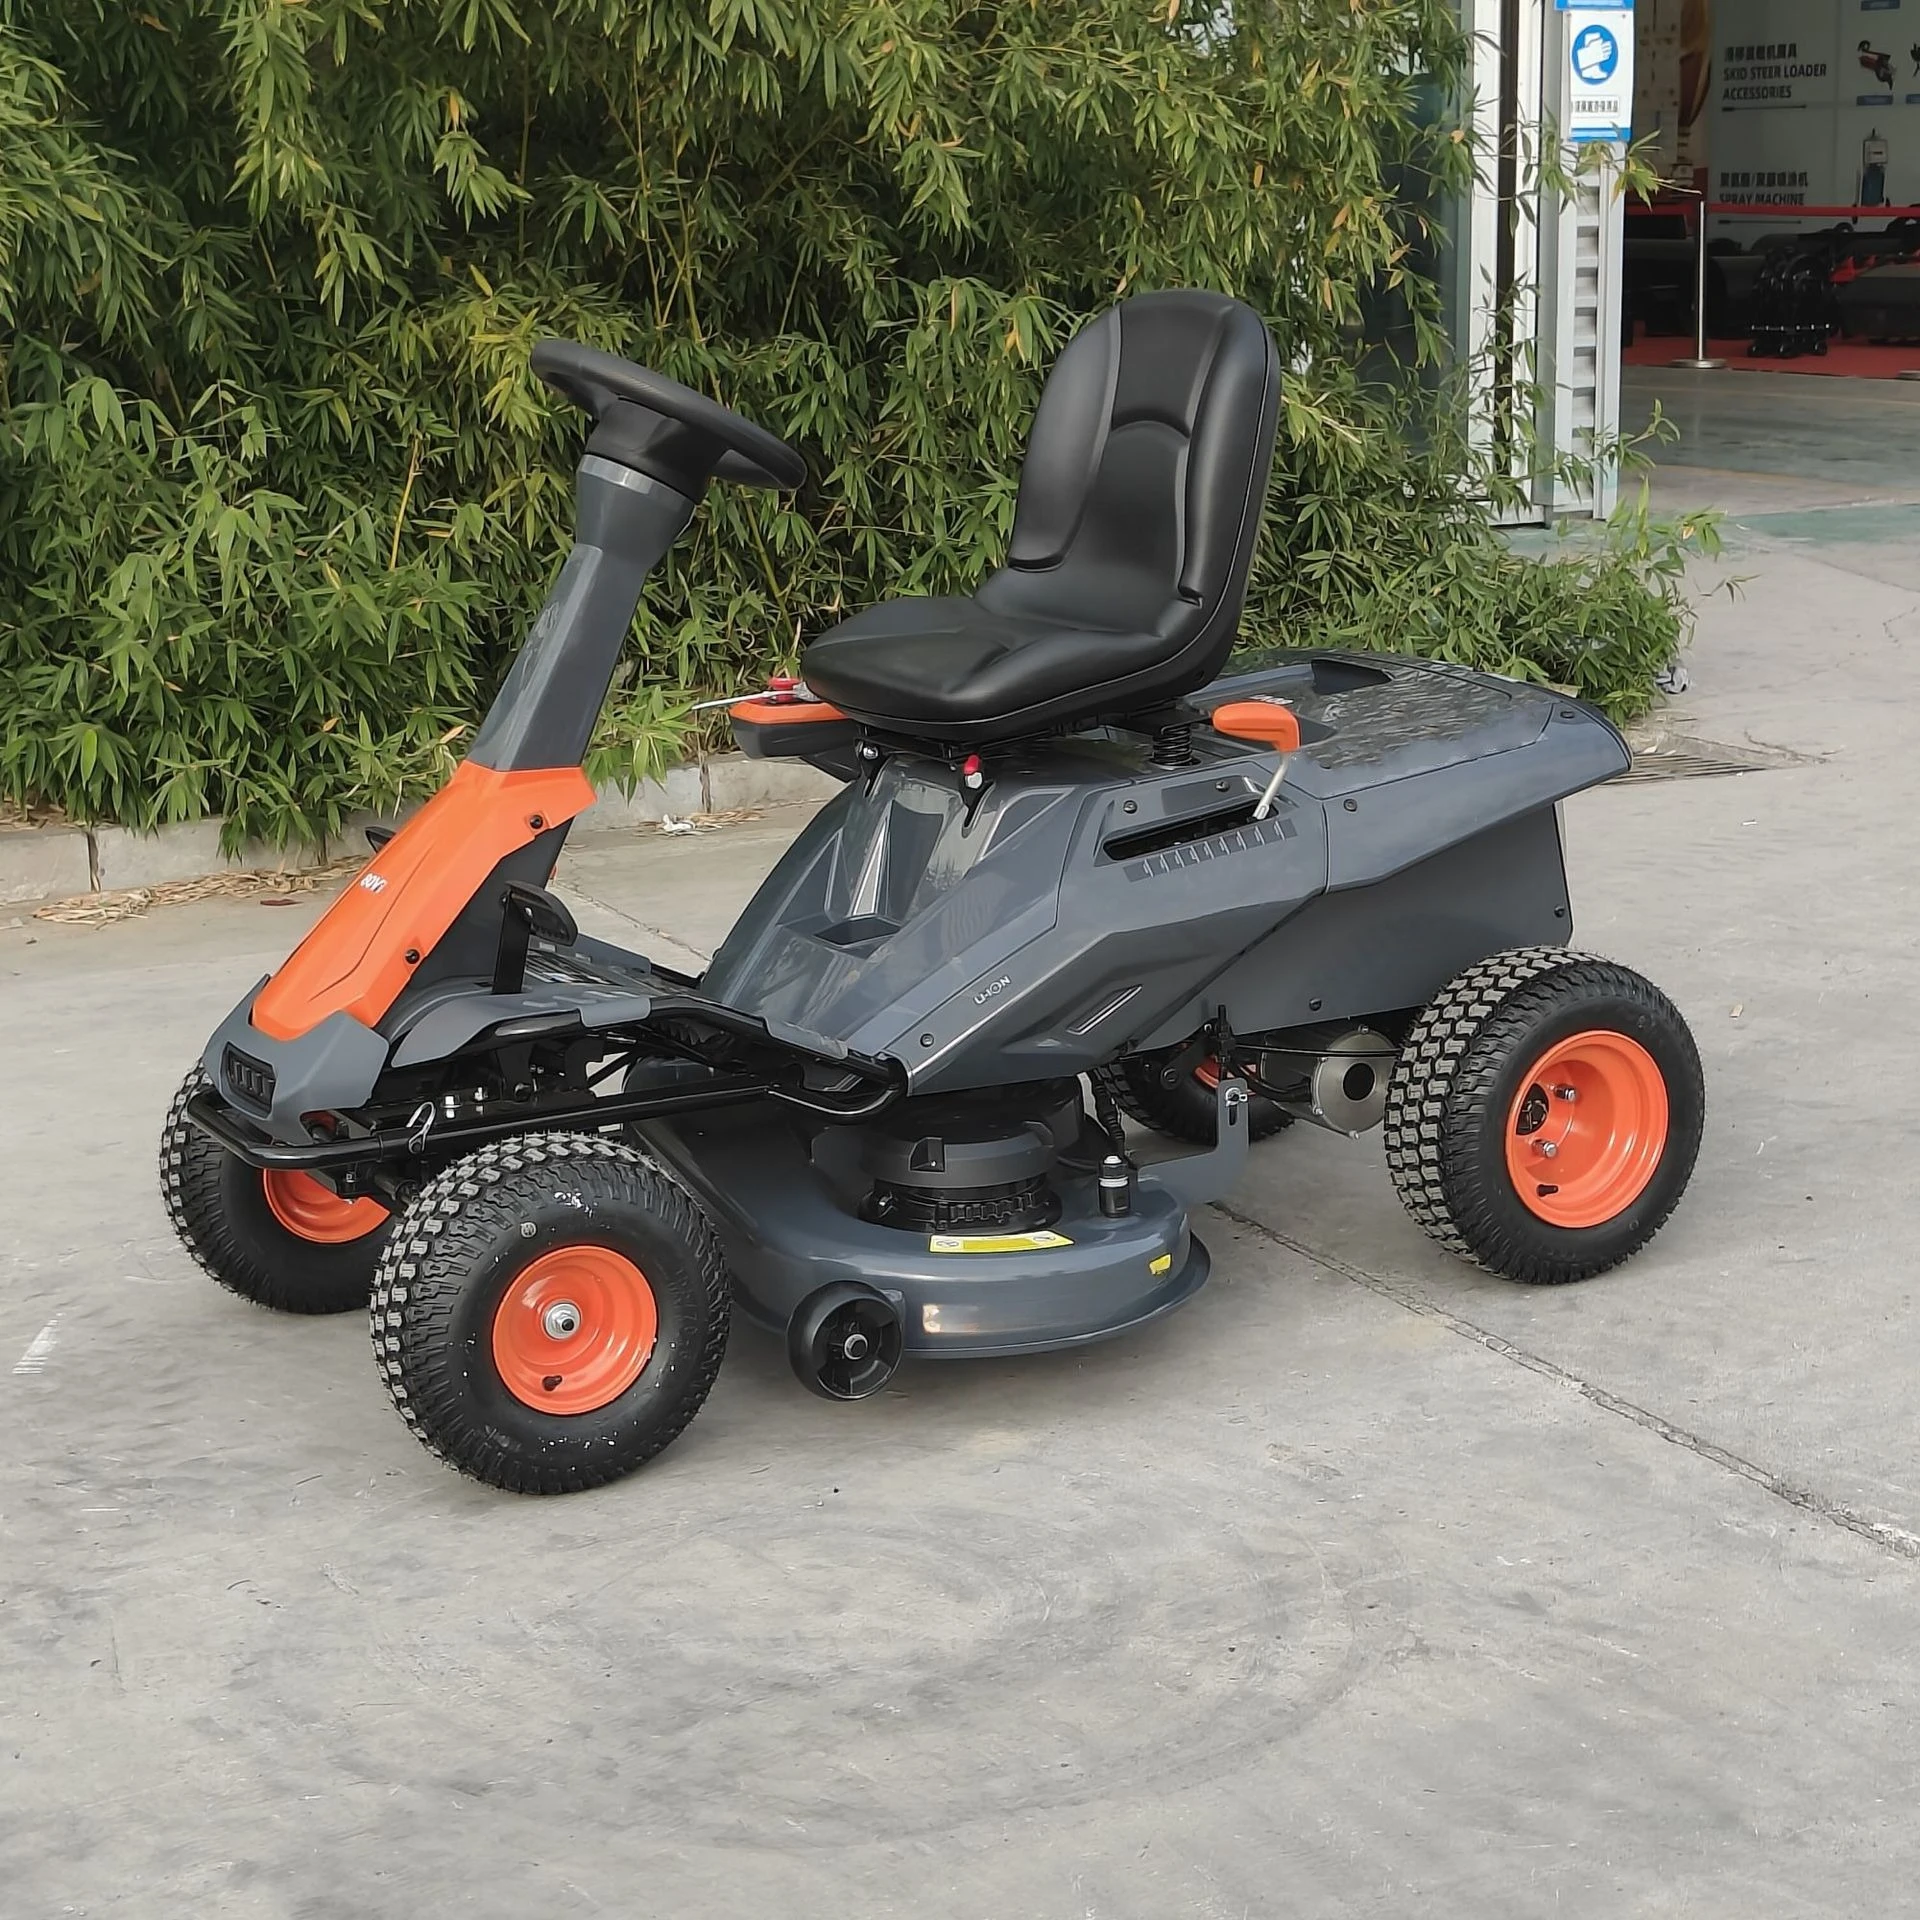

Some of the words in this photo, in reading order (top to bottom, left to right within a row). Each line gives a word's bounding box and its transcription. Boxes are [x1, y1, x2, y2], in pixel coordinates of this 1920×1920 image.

[1723, 67, 1747, 81] SKID
[1750, 66, 1781, 80] STEER
[1783, 64, 1827, 78] LOADER
[1722, 85, 1792, 101] ACCESSORIES
[1719, 193, 1752, 205] SPRAY
[1754, 193, 1805, 206] MACHINE
